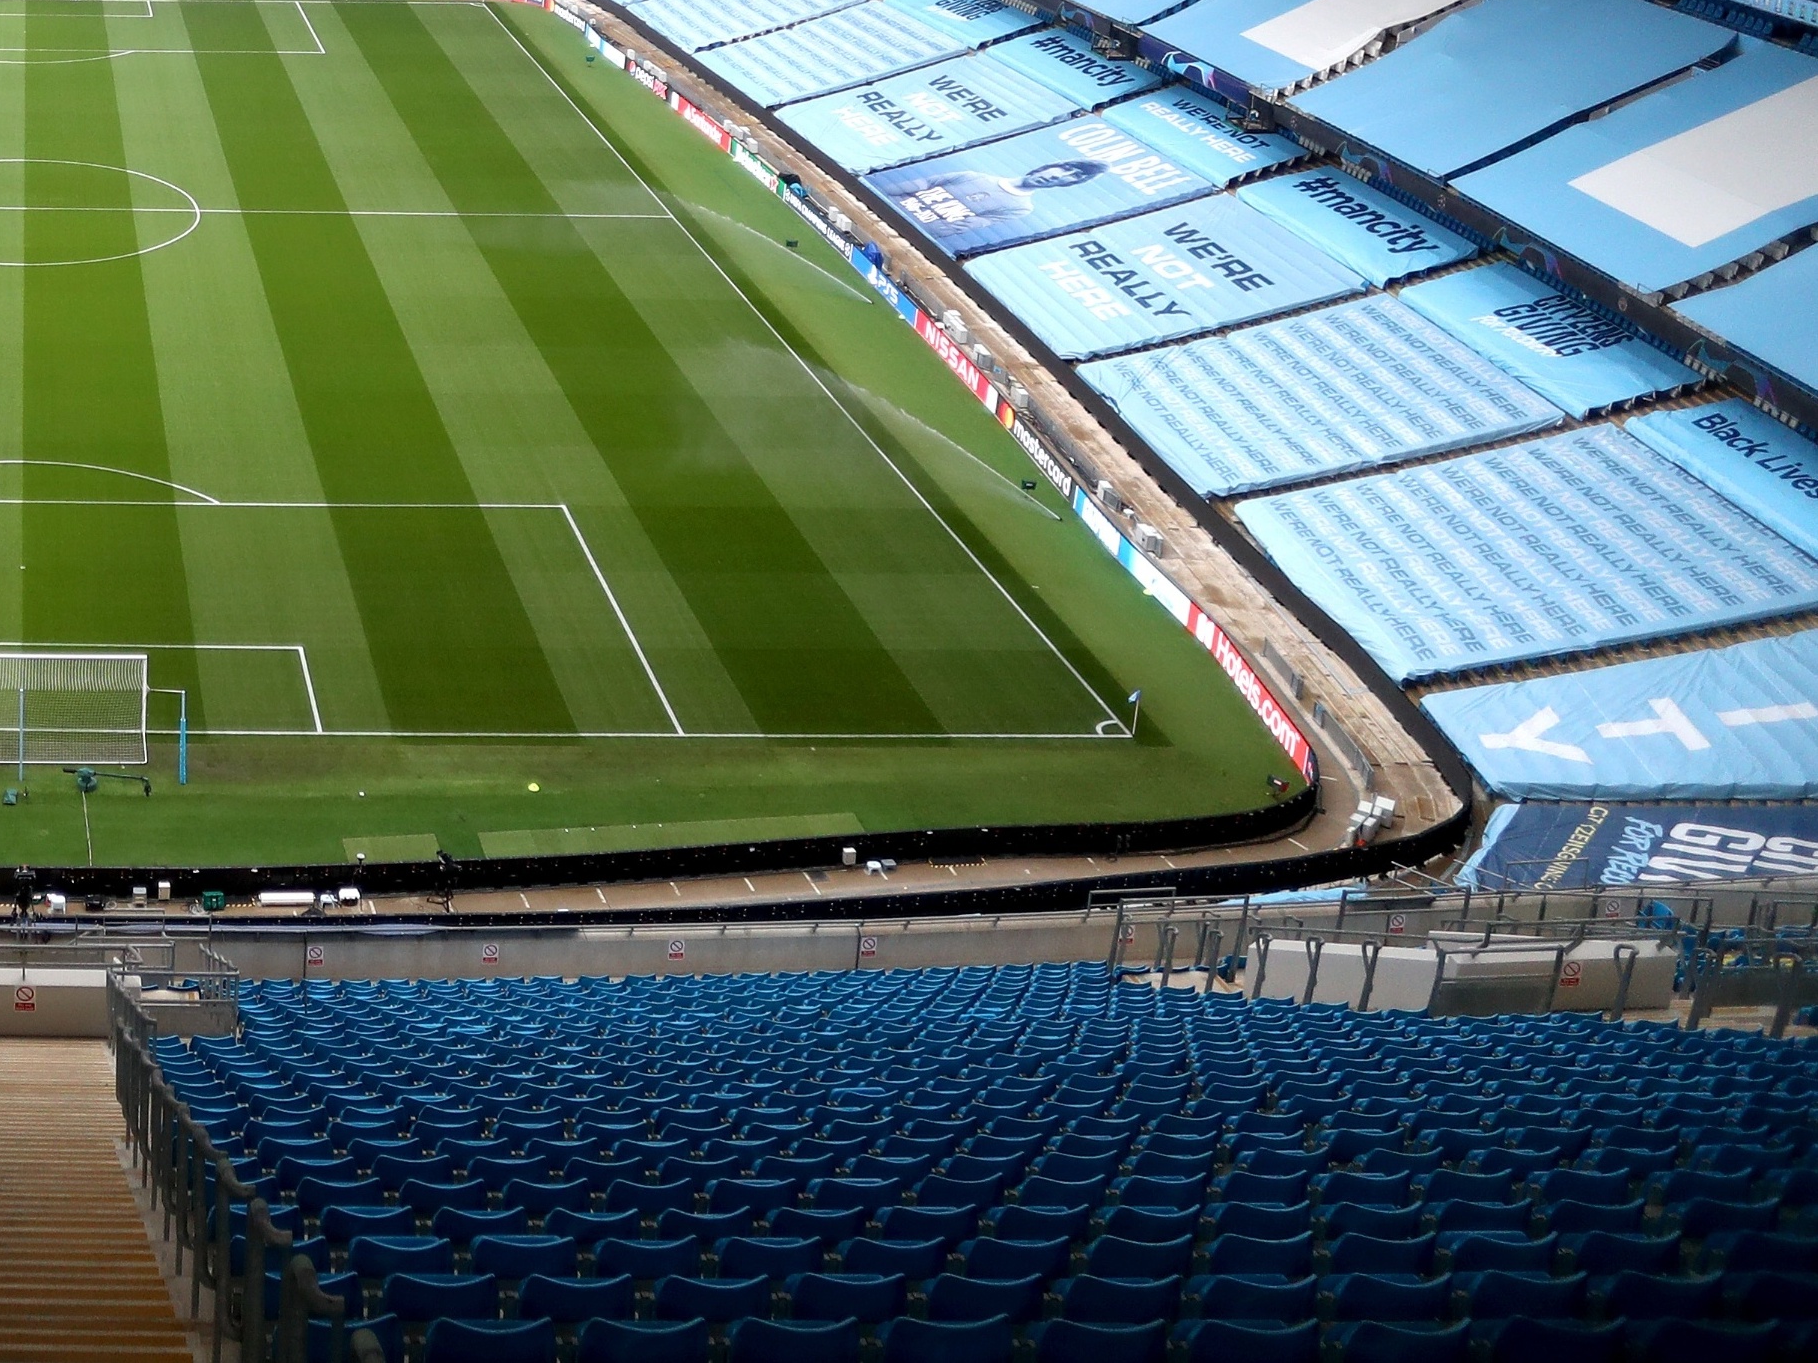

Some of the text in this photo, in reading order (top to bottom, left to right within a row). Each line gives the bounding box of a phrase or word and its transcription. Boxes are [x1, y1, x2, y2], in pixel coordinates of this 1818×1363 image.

[635, 66, 655, 90] pepsi
[1030, 35, 1136, 87] #mancity
[689, 107, 723, 145] Santander
[856, 91, 945, 142] REALLY
[928, 75, 1008, 122] WE'RE
[1172, 98, 1272, 150] WE'RE NOT
[1058, 123, 1193, 196] COLIN BELL
[1140, 101, 1257, 163] REALLY HERE
[802, 205, 827, 235] CHAMPIONS
[827, 228, 846, 251] LEAGUE
[1292, 176, 1440, 254] #mancity
[1068, 240, 1192, 317] REALLY
[1130, 244, 1215, 290] NOT
[1162, 221, 1276, 292] WE'RE
[878, 273, 899, 305] PS5
[1037, 260, 1133, 321] HERE
[1493, 304, 1601, 357] GIVING
[1532, 293, 1635, 349] CITYZENS
[924, 326, 980, 392] NISSAN
[1360, 303, 1407, 336] WE'RE
[1402, 333, 1438, 361] NOT
[1430, 353, 1490, 394] REALLY
[1479, 386, 1530, 421] HERE
[1014, 419, 1072, 497] mastercard
[1691, 412, 1818, 500] Black Lives
[1572, 436, 1799, 597] WE'RE NOT REALLY HERE
[1356, 483, 1537, 645] WE'RE NOT REALLY HERE
[1216, 631, 1301, 758] Hotels.com
